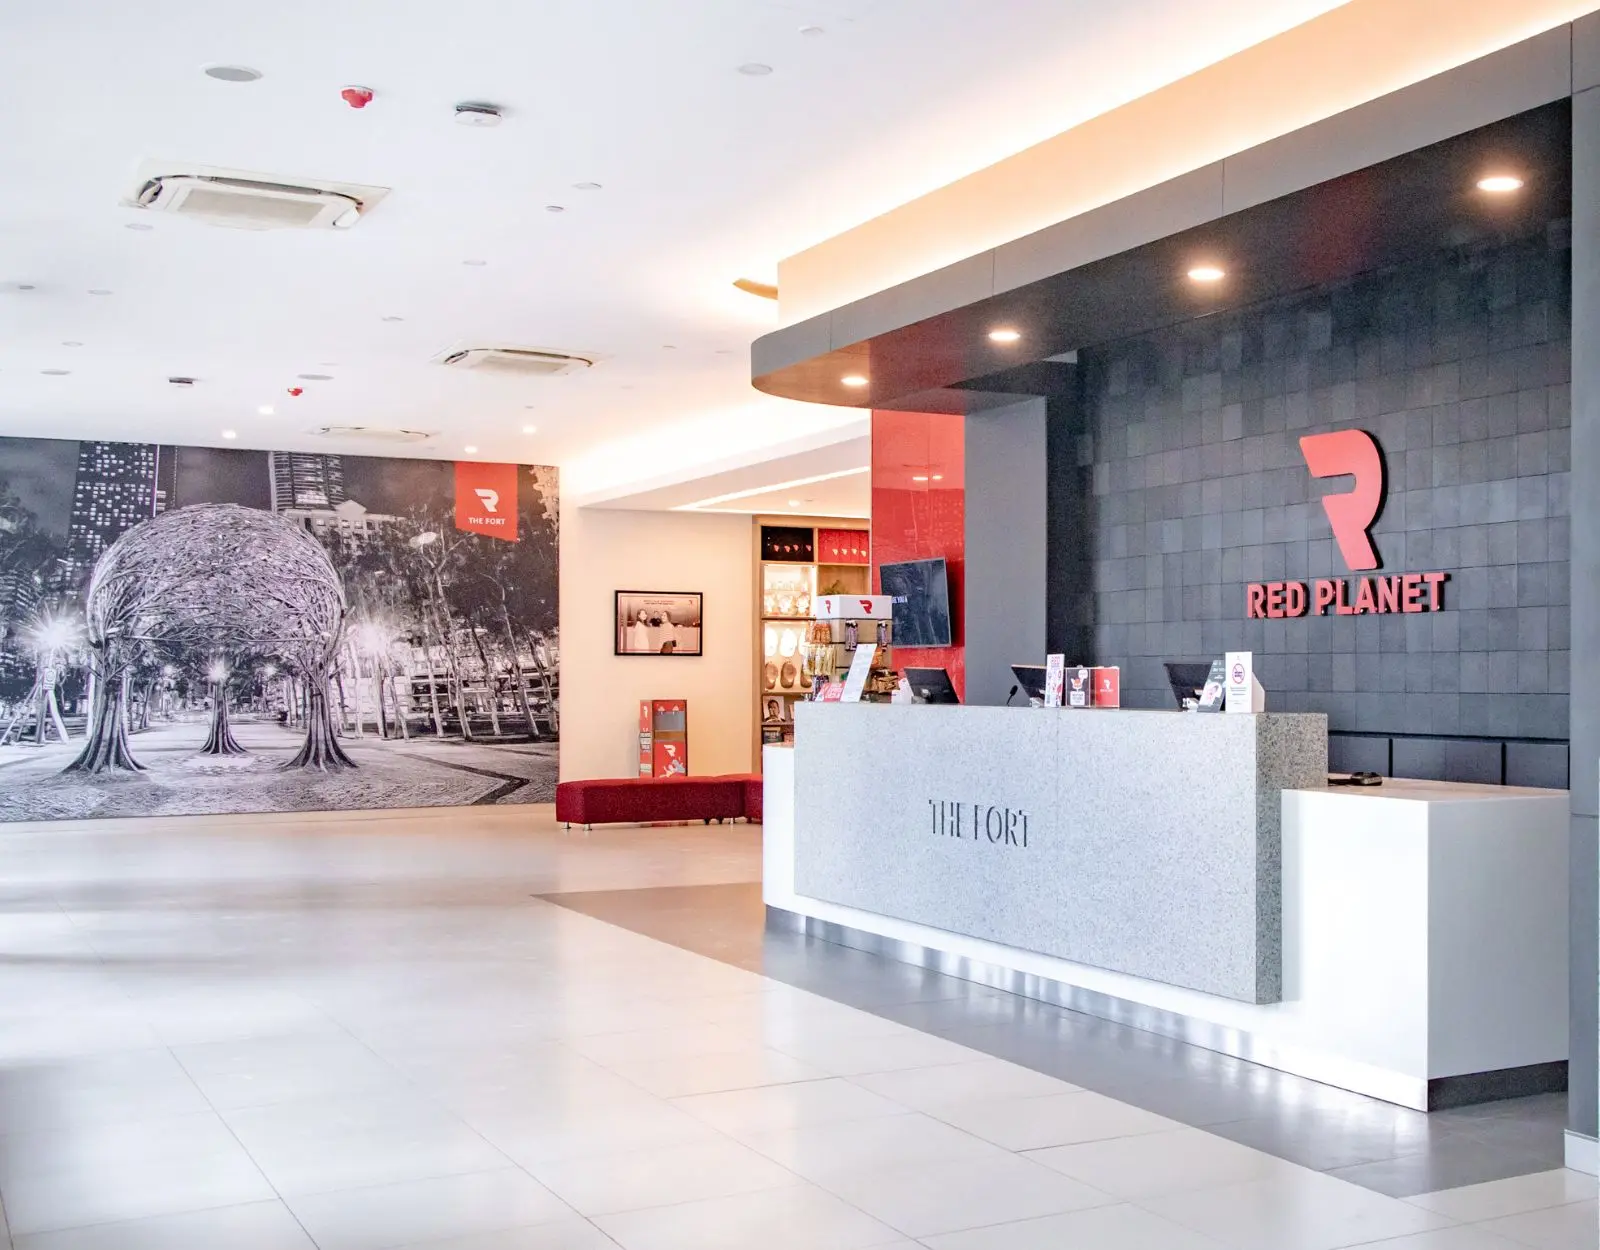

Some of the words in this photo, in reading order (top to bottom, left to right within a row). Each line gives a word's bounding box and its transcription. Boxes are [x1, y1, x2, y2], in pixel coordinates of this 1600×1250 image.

[468, 517, 483, 525] THE
[1247, 582, 1310, 619] RED
[1314, 572, 1451, 616] PLANET
[928, 799, 965, 838] THE
[974, 804, 1030, 848] FORT
